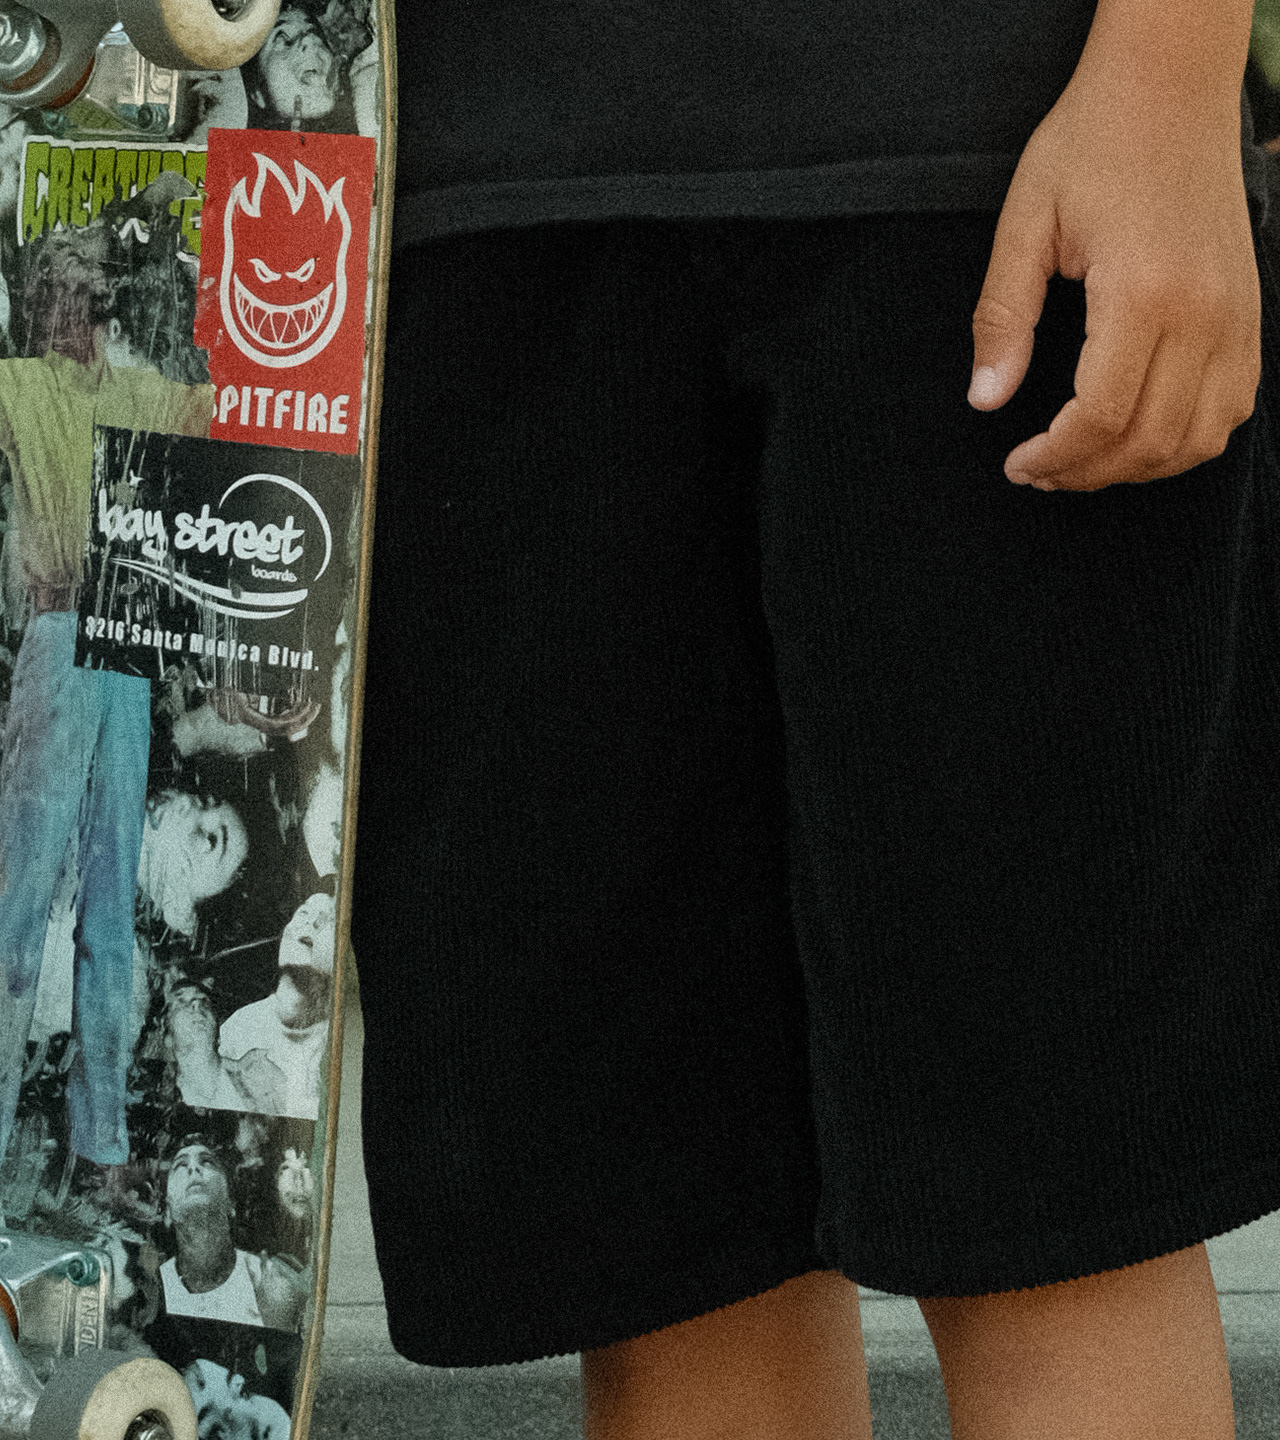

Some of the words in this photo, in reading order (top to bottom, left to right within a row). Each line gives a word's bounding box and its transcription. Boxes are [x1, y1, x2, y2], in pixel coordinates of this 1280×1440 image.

[211, 383, 350, 435] PITFIRE
[99, 488, 168, 561] bay
[174, 504, 305, 565] street
[251, 564, 297, 583] boards
[131, 624, 183, 651] Santa
[268, 645, 319, 671] Blvd.
